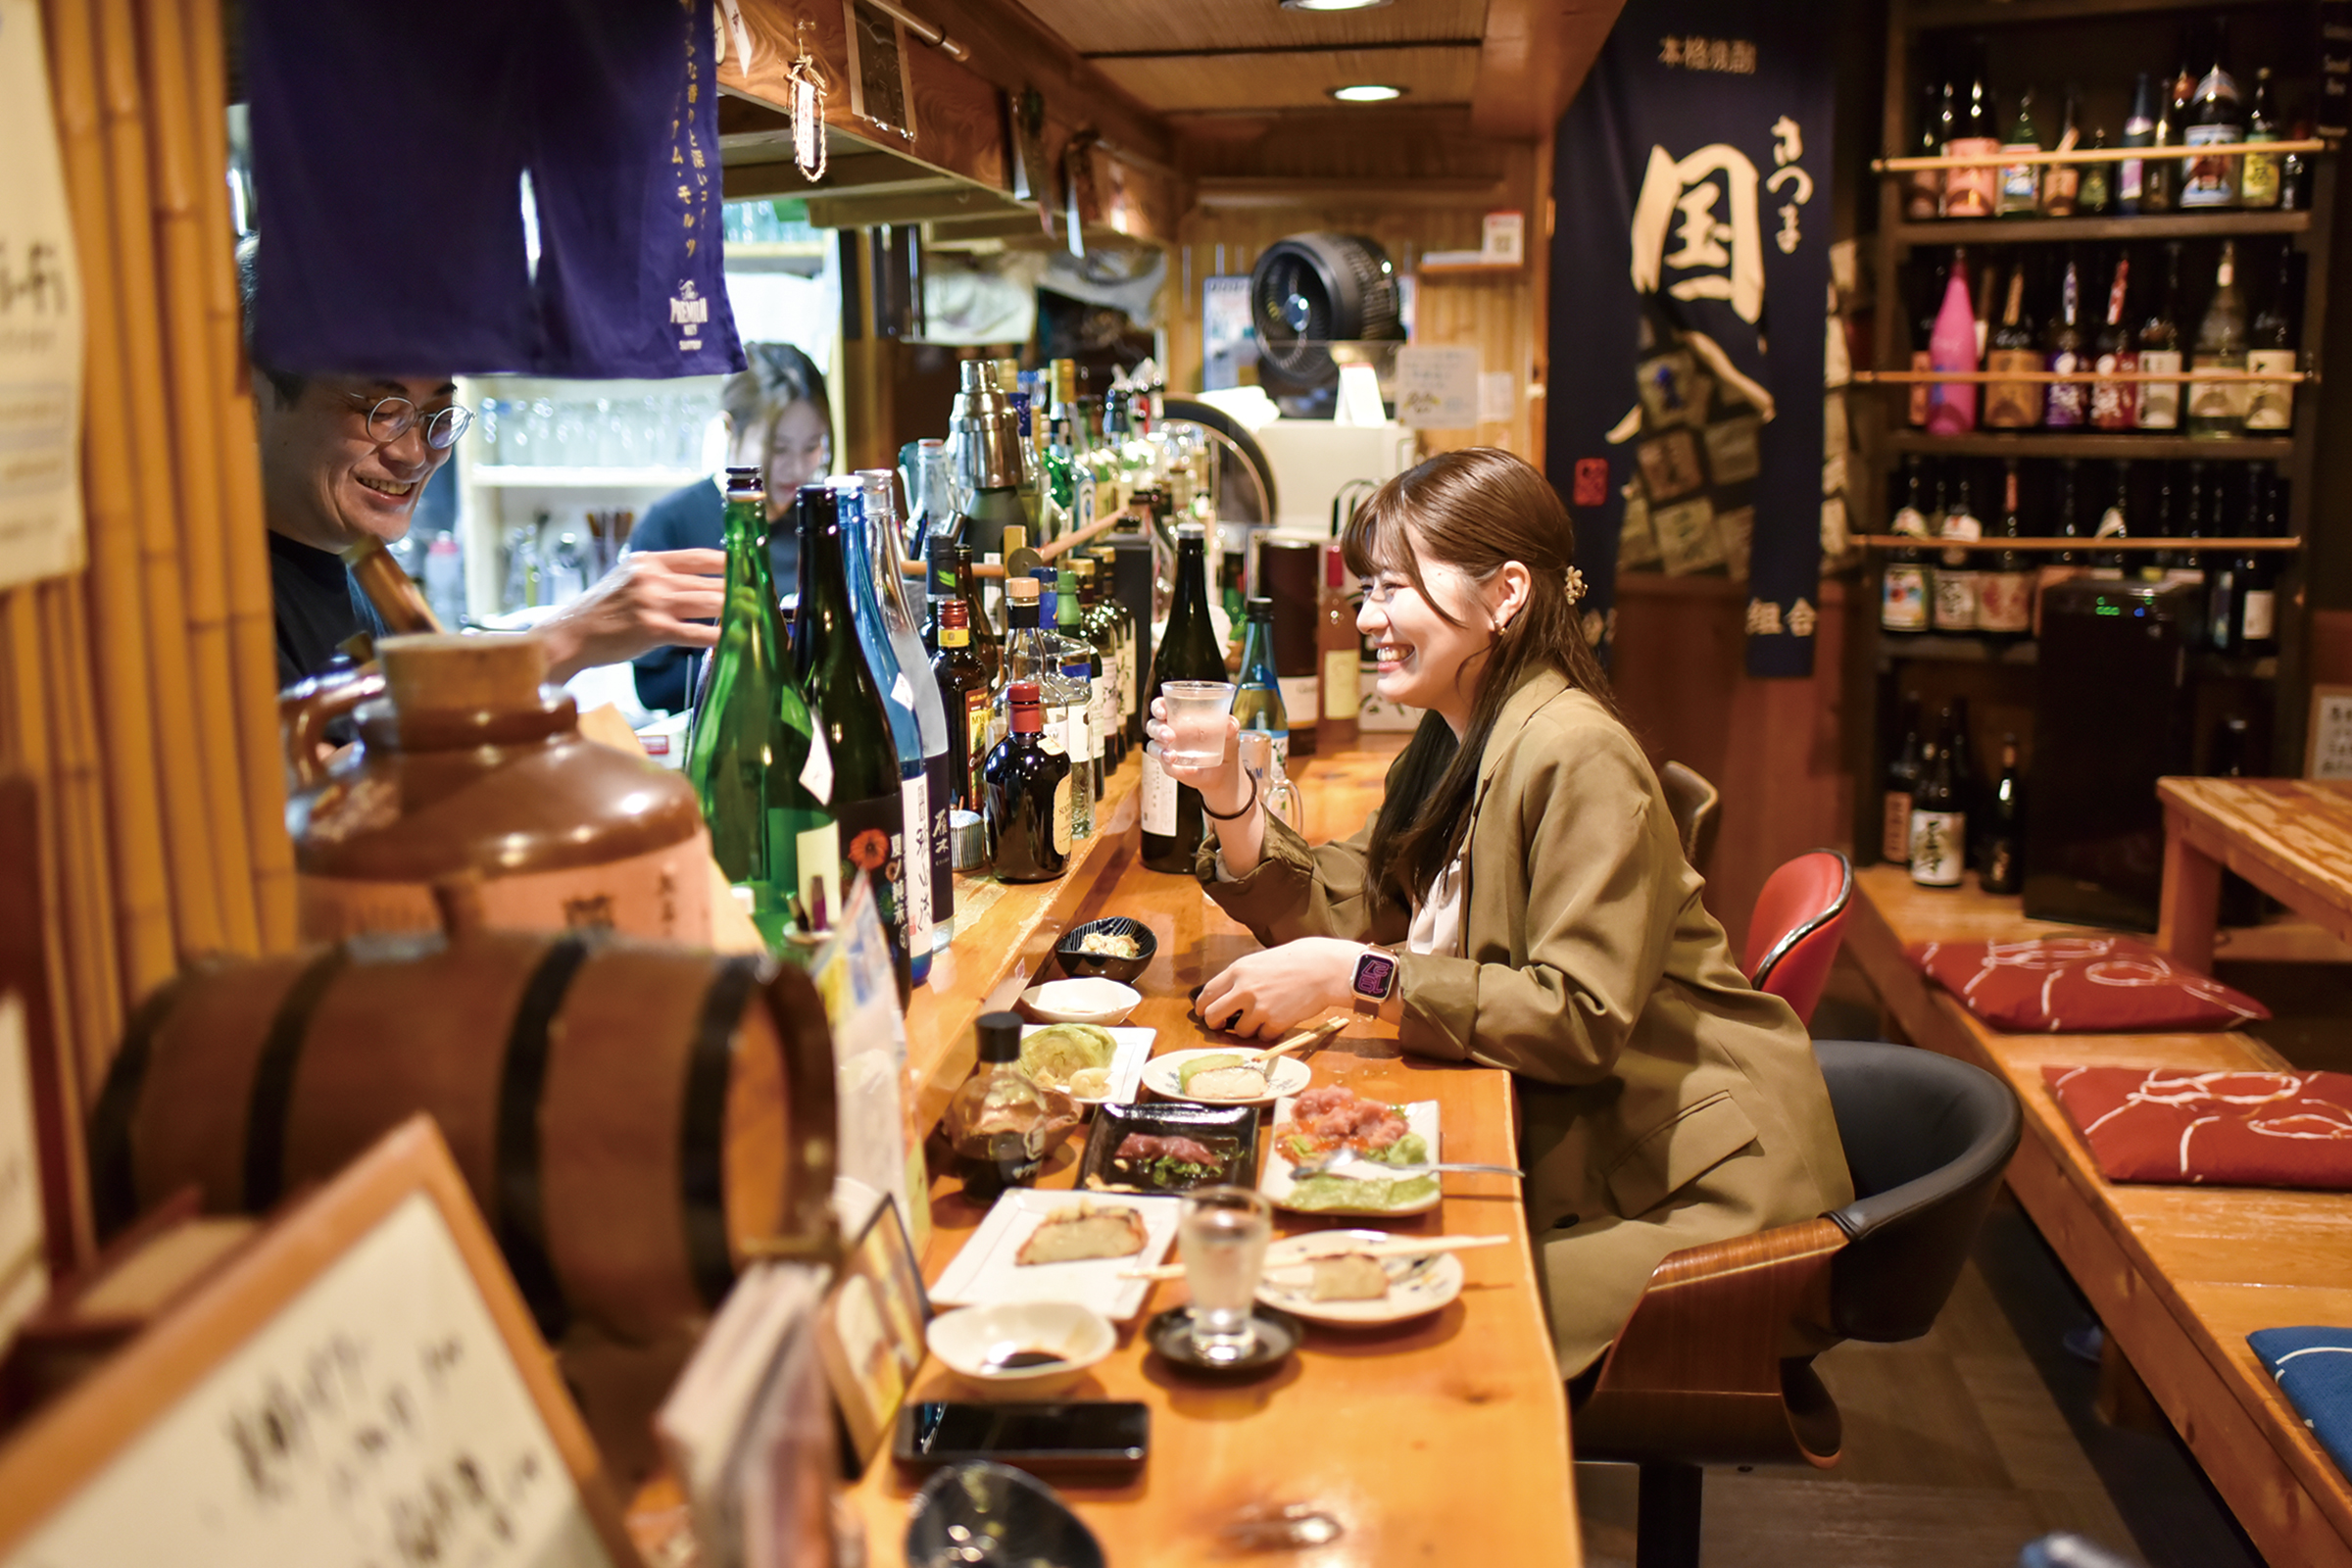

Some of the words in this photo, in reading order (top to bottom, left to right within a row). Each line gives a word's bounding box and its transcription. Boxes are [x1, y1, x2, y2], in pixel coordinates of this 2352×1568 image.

[1766, 115, 1813, 254] さつま
[932, 808, 950, 854] 雁木
